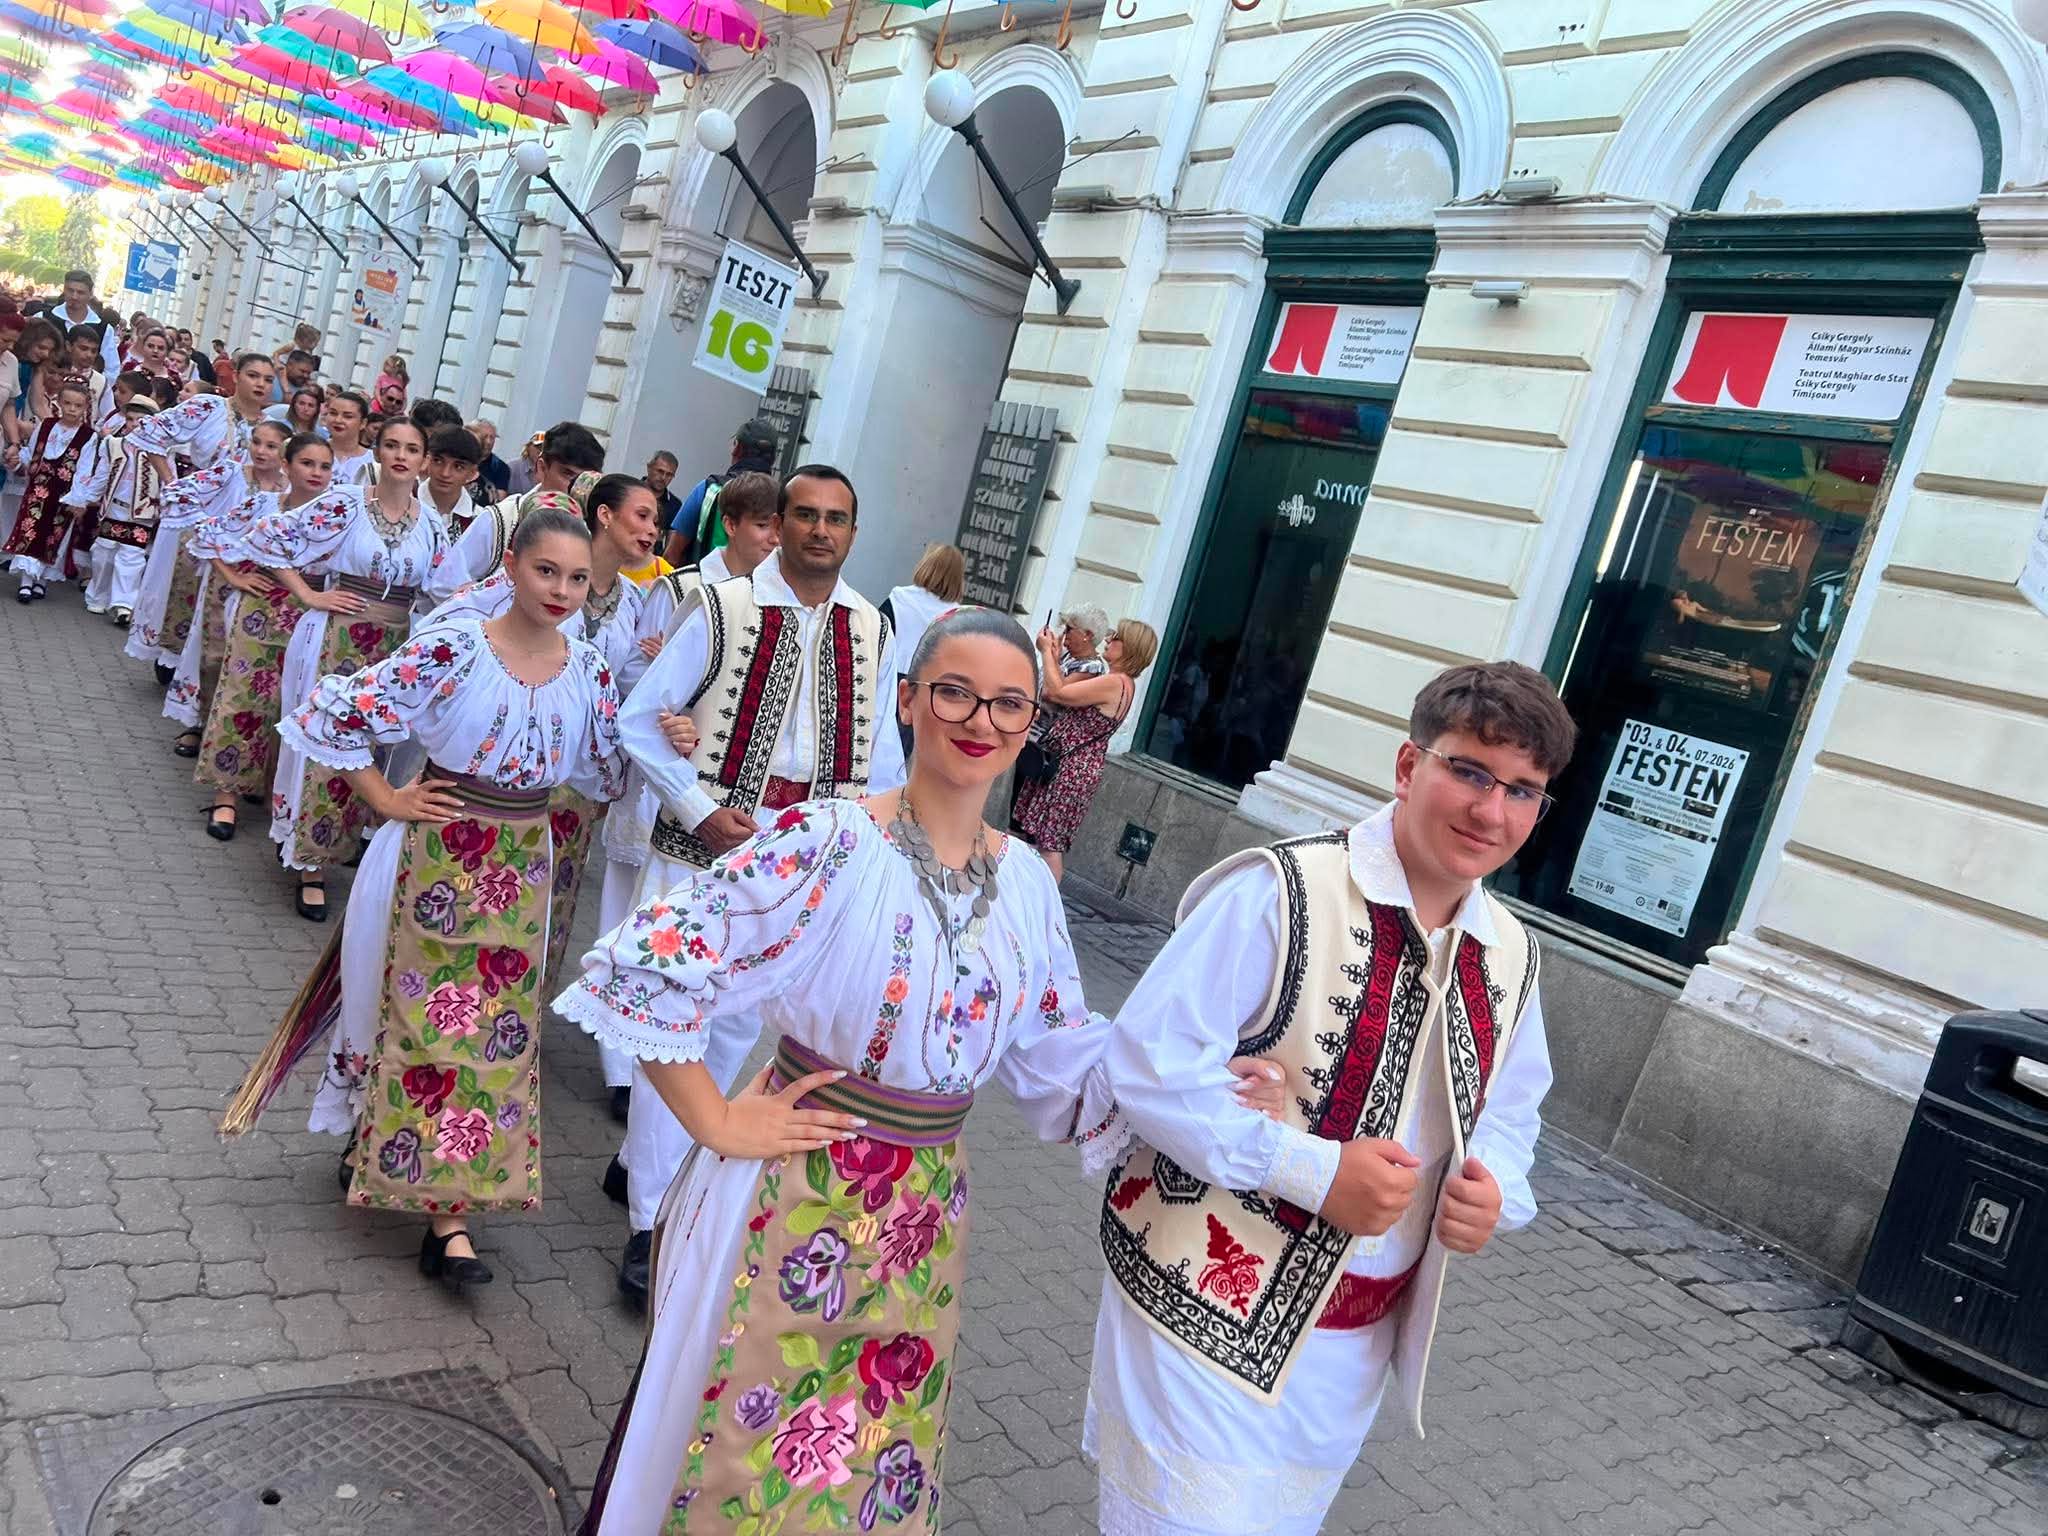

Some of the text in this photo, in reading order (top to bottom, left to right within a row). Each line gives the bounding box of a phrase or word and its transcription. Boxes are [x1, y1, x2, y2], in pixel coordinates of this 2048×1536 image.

[725, 256, 792, 310] TESZT
[706, 309, 773, 373] 16
[1807, 341, 1913, 355] Állami Magyar Színház
[1811, 331, 1873, 344] Csiky Gergely
[1804, 353, 1849, 363] Temesvár
[1795, 379, 1857, 392] Csiky Gergely
[1799, 368, 1909, 383] Teatrul Maghiar de Stat
[1696, 519, 1803, 565] FESTEN
[1629, 724, 1736, 770] 03. & 04. 07.2026
[1615, 744, 1731, 805] FESTEN
